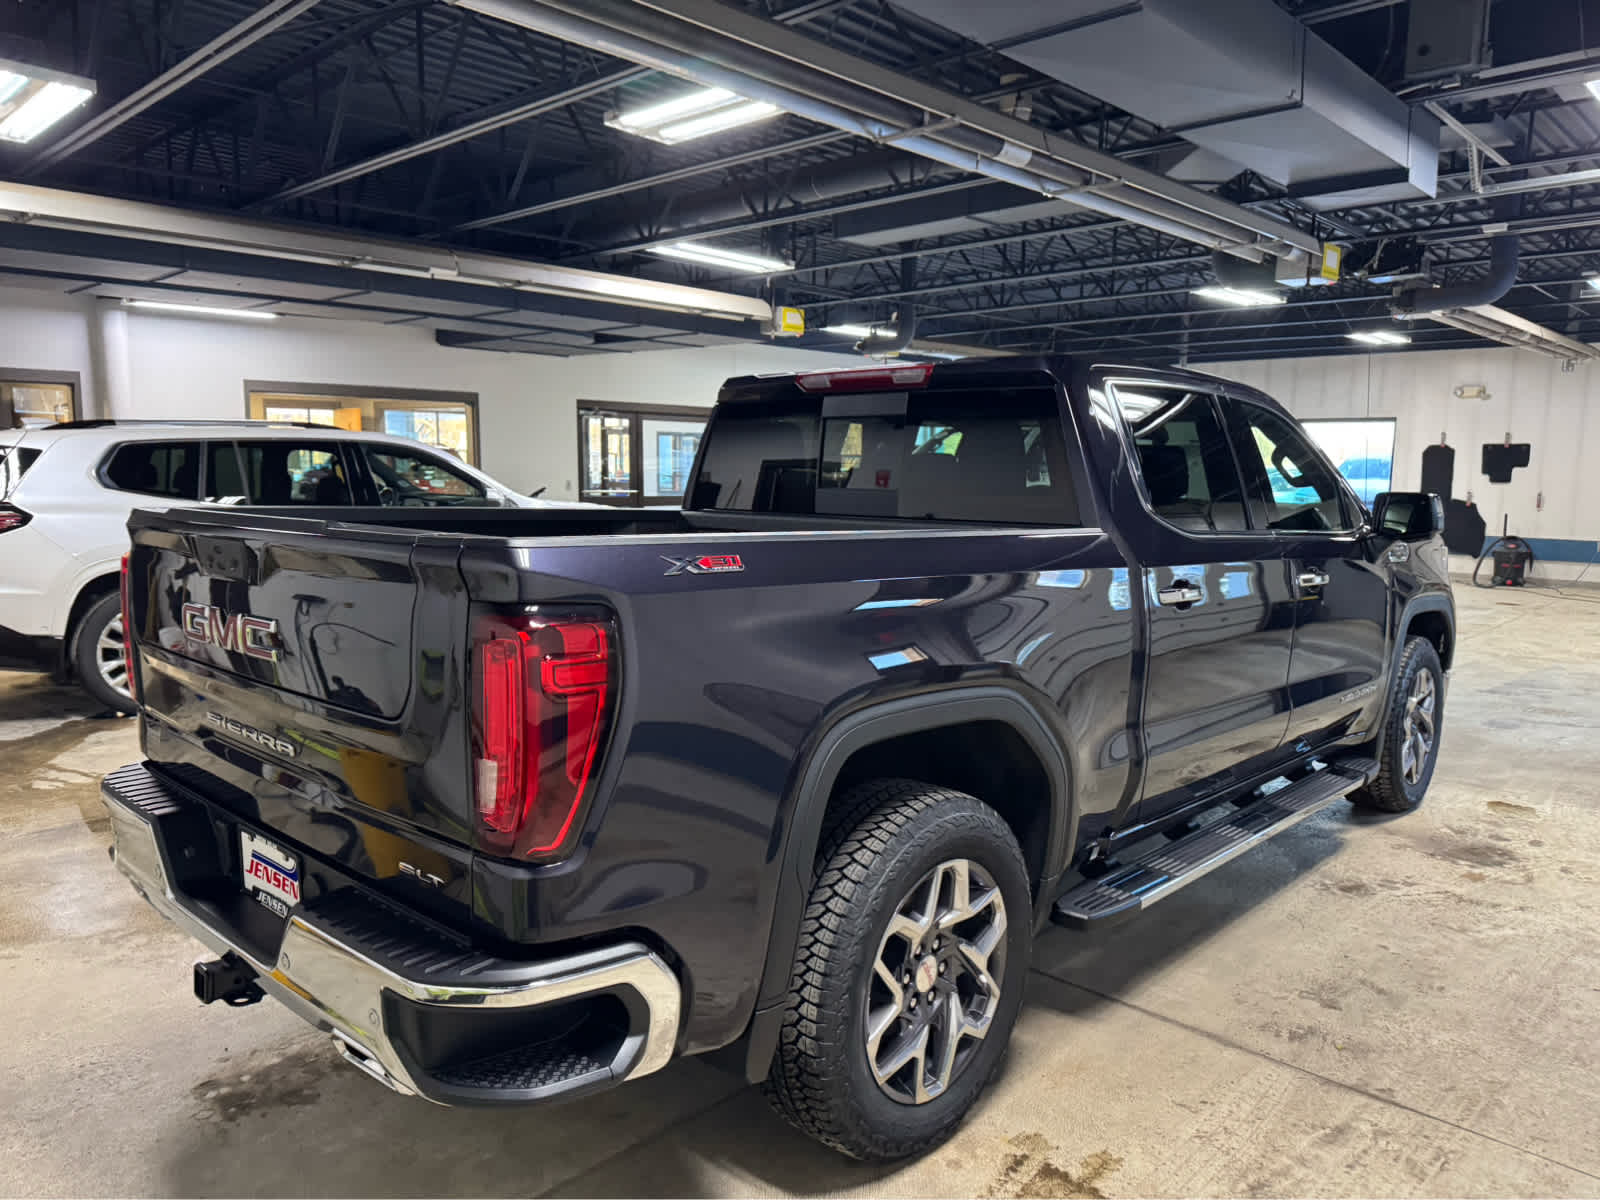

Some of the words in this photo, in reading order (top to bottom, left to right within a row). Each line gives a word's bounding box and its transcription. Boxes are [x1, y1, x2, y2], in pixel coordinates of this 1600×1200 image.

[182, 602, 278, 663] GMC
[206, 711, 296, 757] SIERRA
[245, 858, 299, 901] JENSEN
[398, 861, 446, 888] SLT
[256, 890, 289, 917] JENSEN
